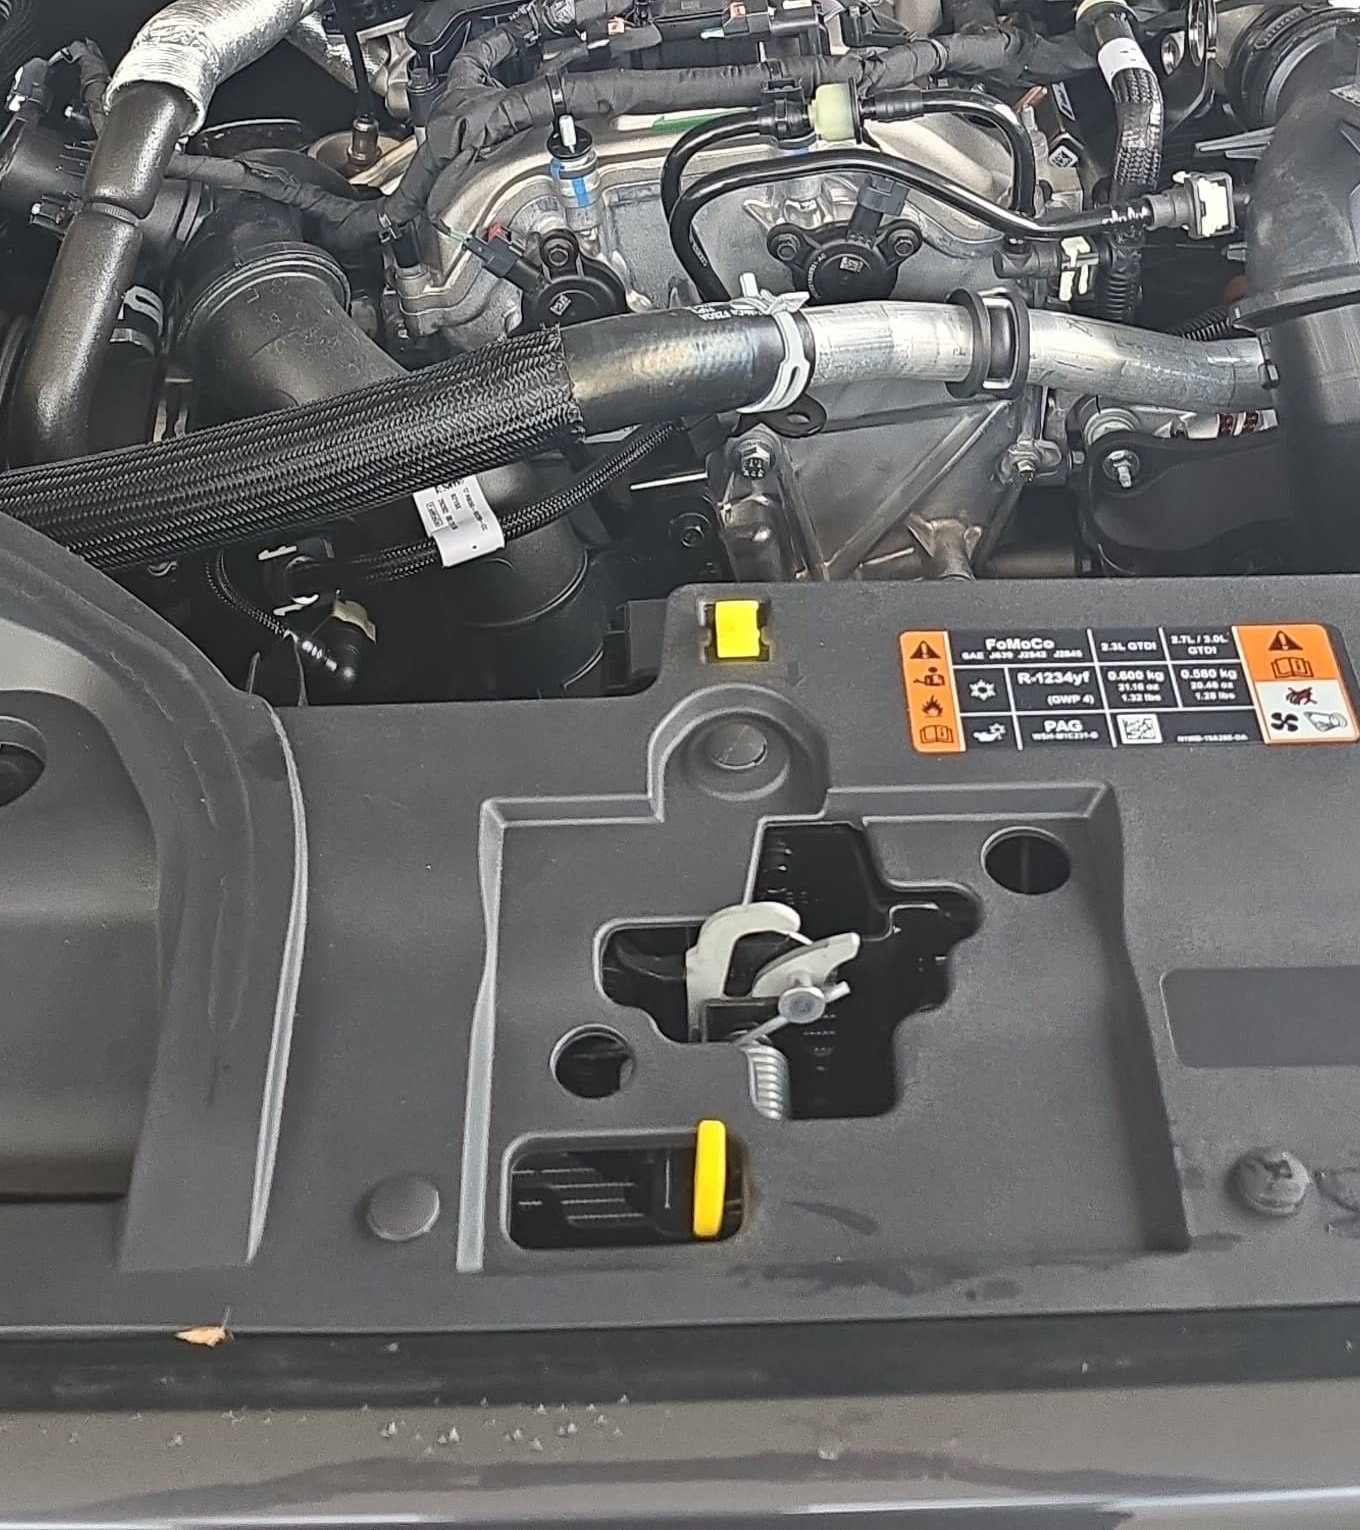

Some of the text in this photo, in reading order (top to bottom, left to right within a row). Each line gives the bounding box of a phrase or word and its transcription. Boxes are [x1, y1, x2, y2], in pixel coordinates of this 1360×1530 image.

[1203, 633, 1229, 644] 3.0L
[985, 638, 1055, 651] FoMoCo
[1100, 641, 1157, 652] 2.3L GTDI
[961, 651, 985, 660] SAE
[1187, 646, 1217, 655] GTDI
[1017, 670, 1090, 687] R-1234yf
[1146, 670, 1165, 683] kg
[1219, 668, 1237, 680] kg
[1146, 683, 1160, 691] oz
[1220, 681, 1234, 689] oz
[1047, 693, 1095, 706] (GWP 4)
[1144, 693, 1161, 702] lbs
[1219, 691, 1236, 700] lbs
[1044, 720, 1083, 732] PAG
